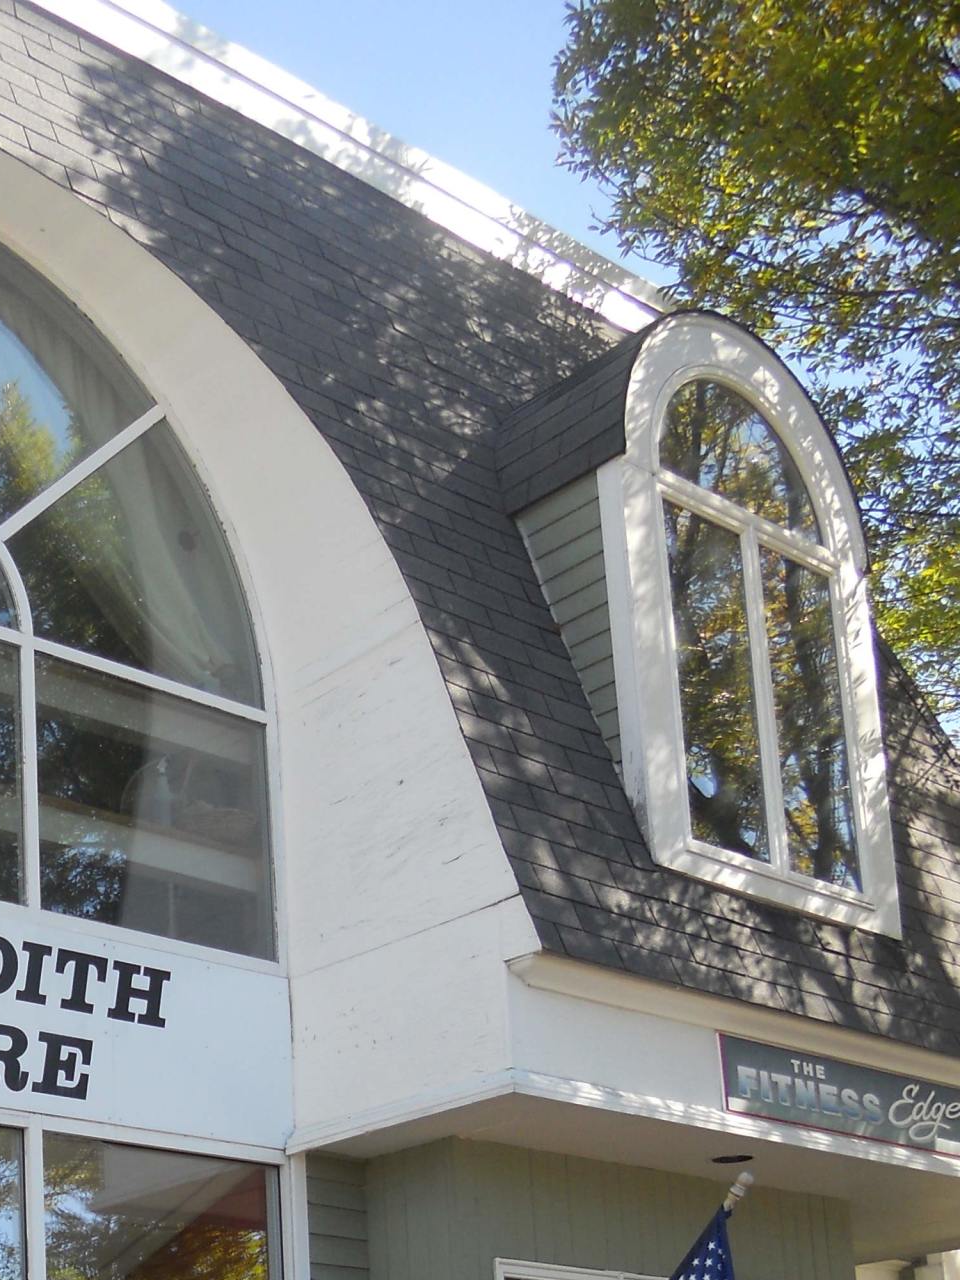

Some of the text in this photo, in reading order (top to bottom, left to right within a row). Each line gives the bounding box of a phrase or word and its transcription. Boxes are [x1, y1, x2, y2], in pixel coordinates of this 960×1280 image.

[791, 1059, 825, 1080] THE
[737, 1065, 960, 1141] FITNESS Edge
